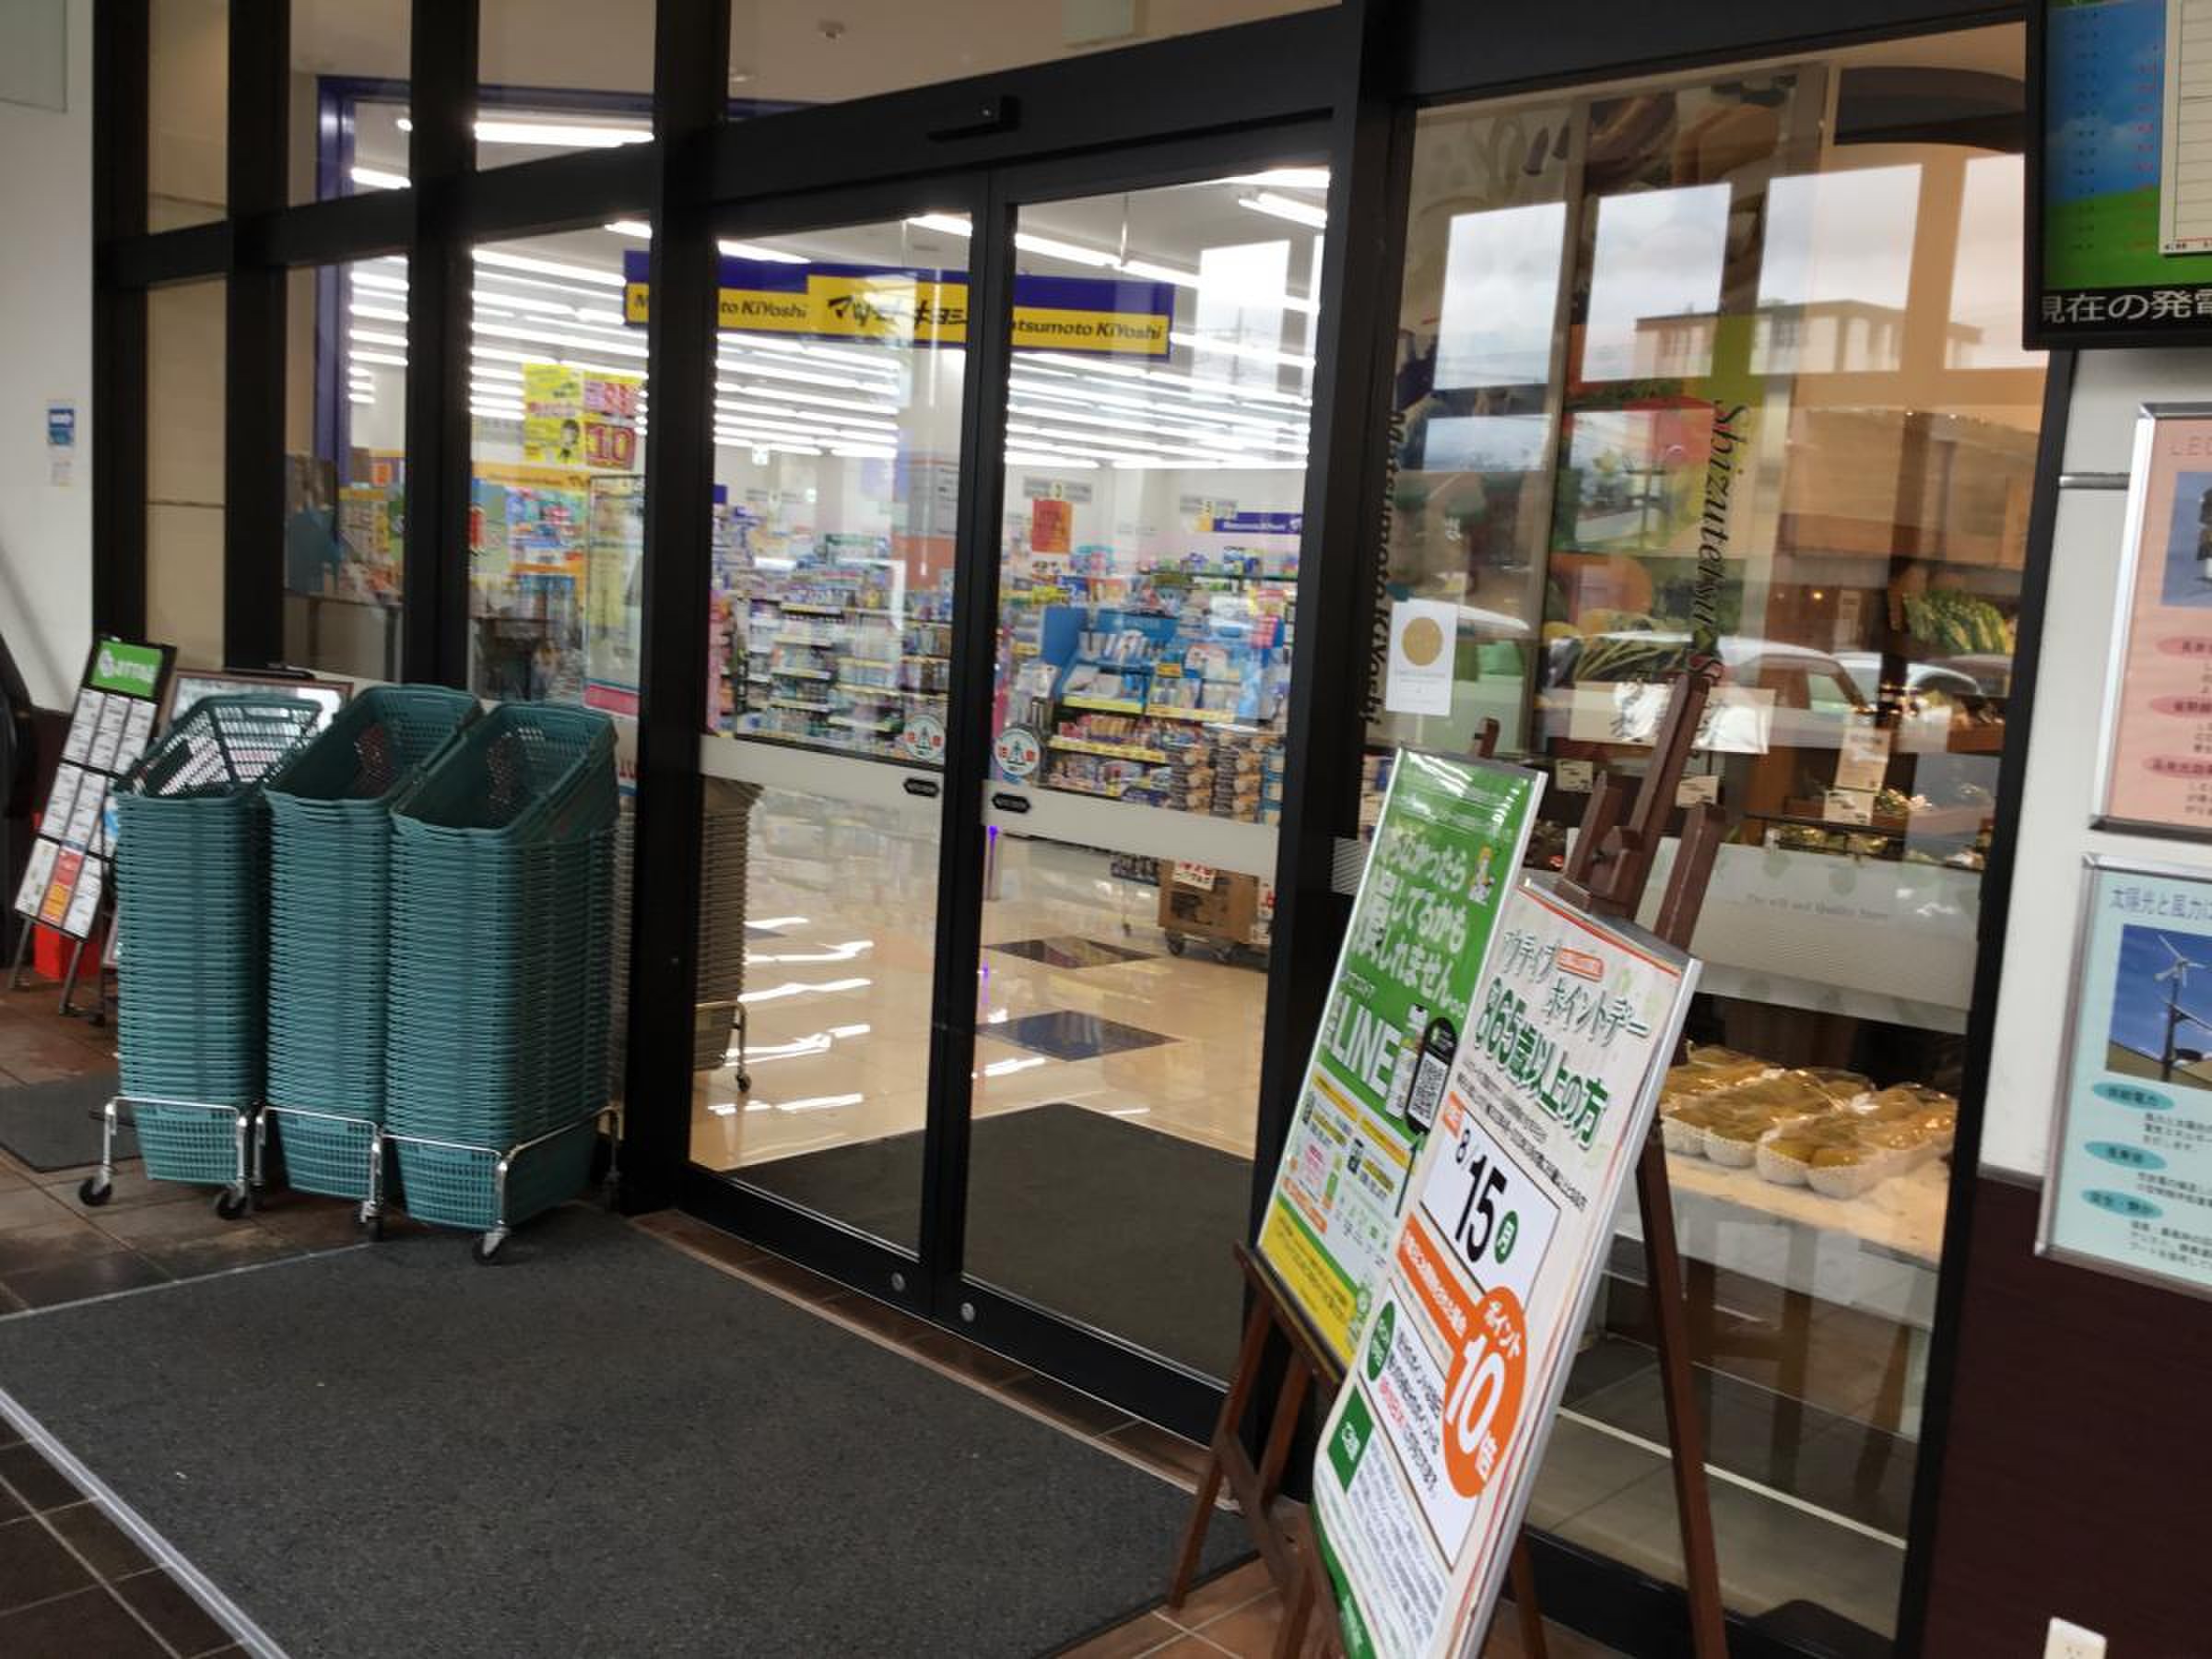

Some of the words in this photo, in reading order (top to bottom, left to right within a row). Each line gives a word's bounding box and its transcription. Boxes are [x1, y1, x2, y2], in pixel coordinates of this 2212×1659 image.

[1012, 318, 1092, 337] tsumoto
[1693, 399, 1748, 627] Shizutetsu
[1330, 994, 1402, 1099] LINE
